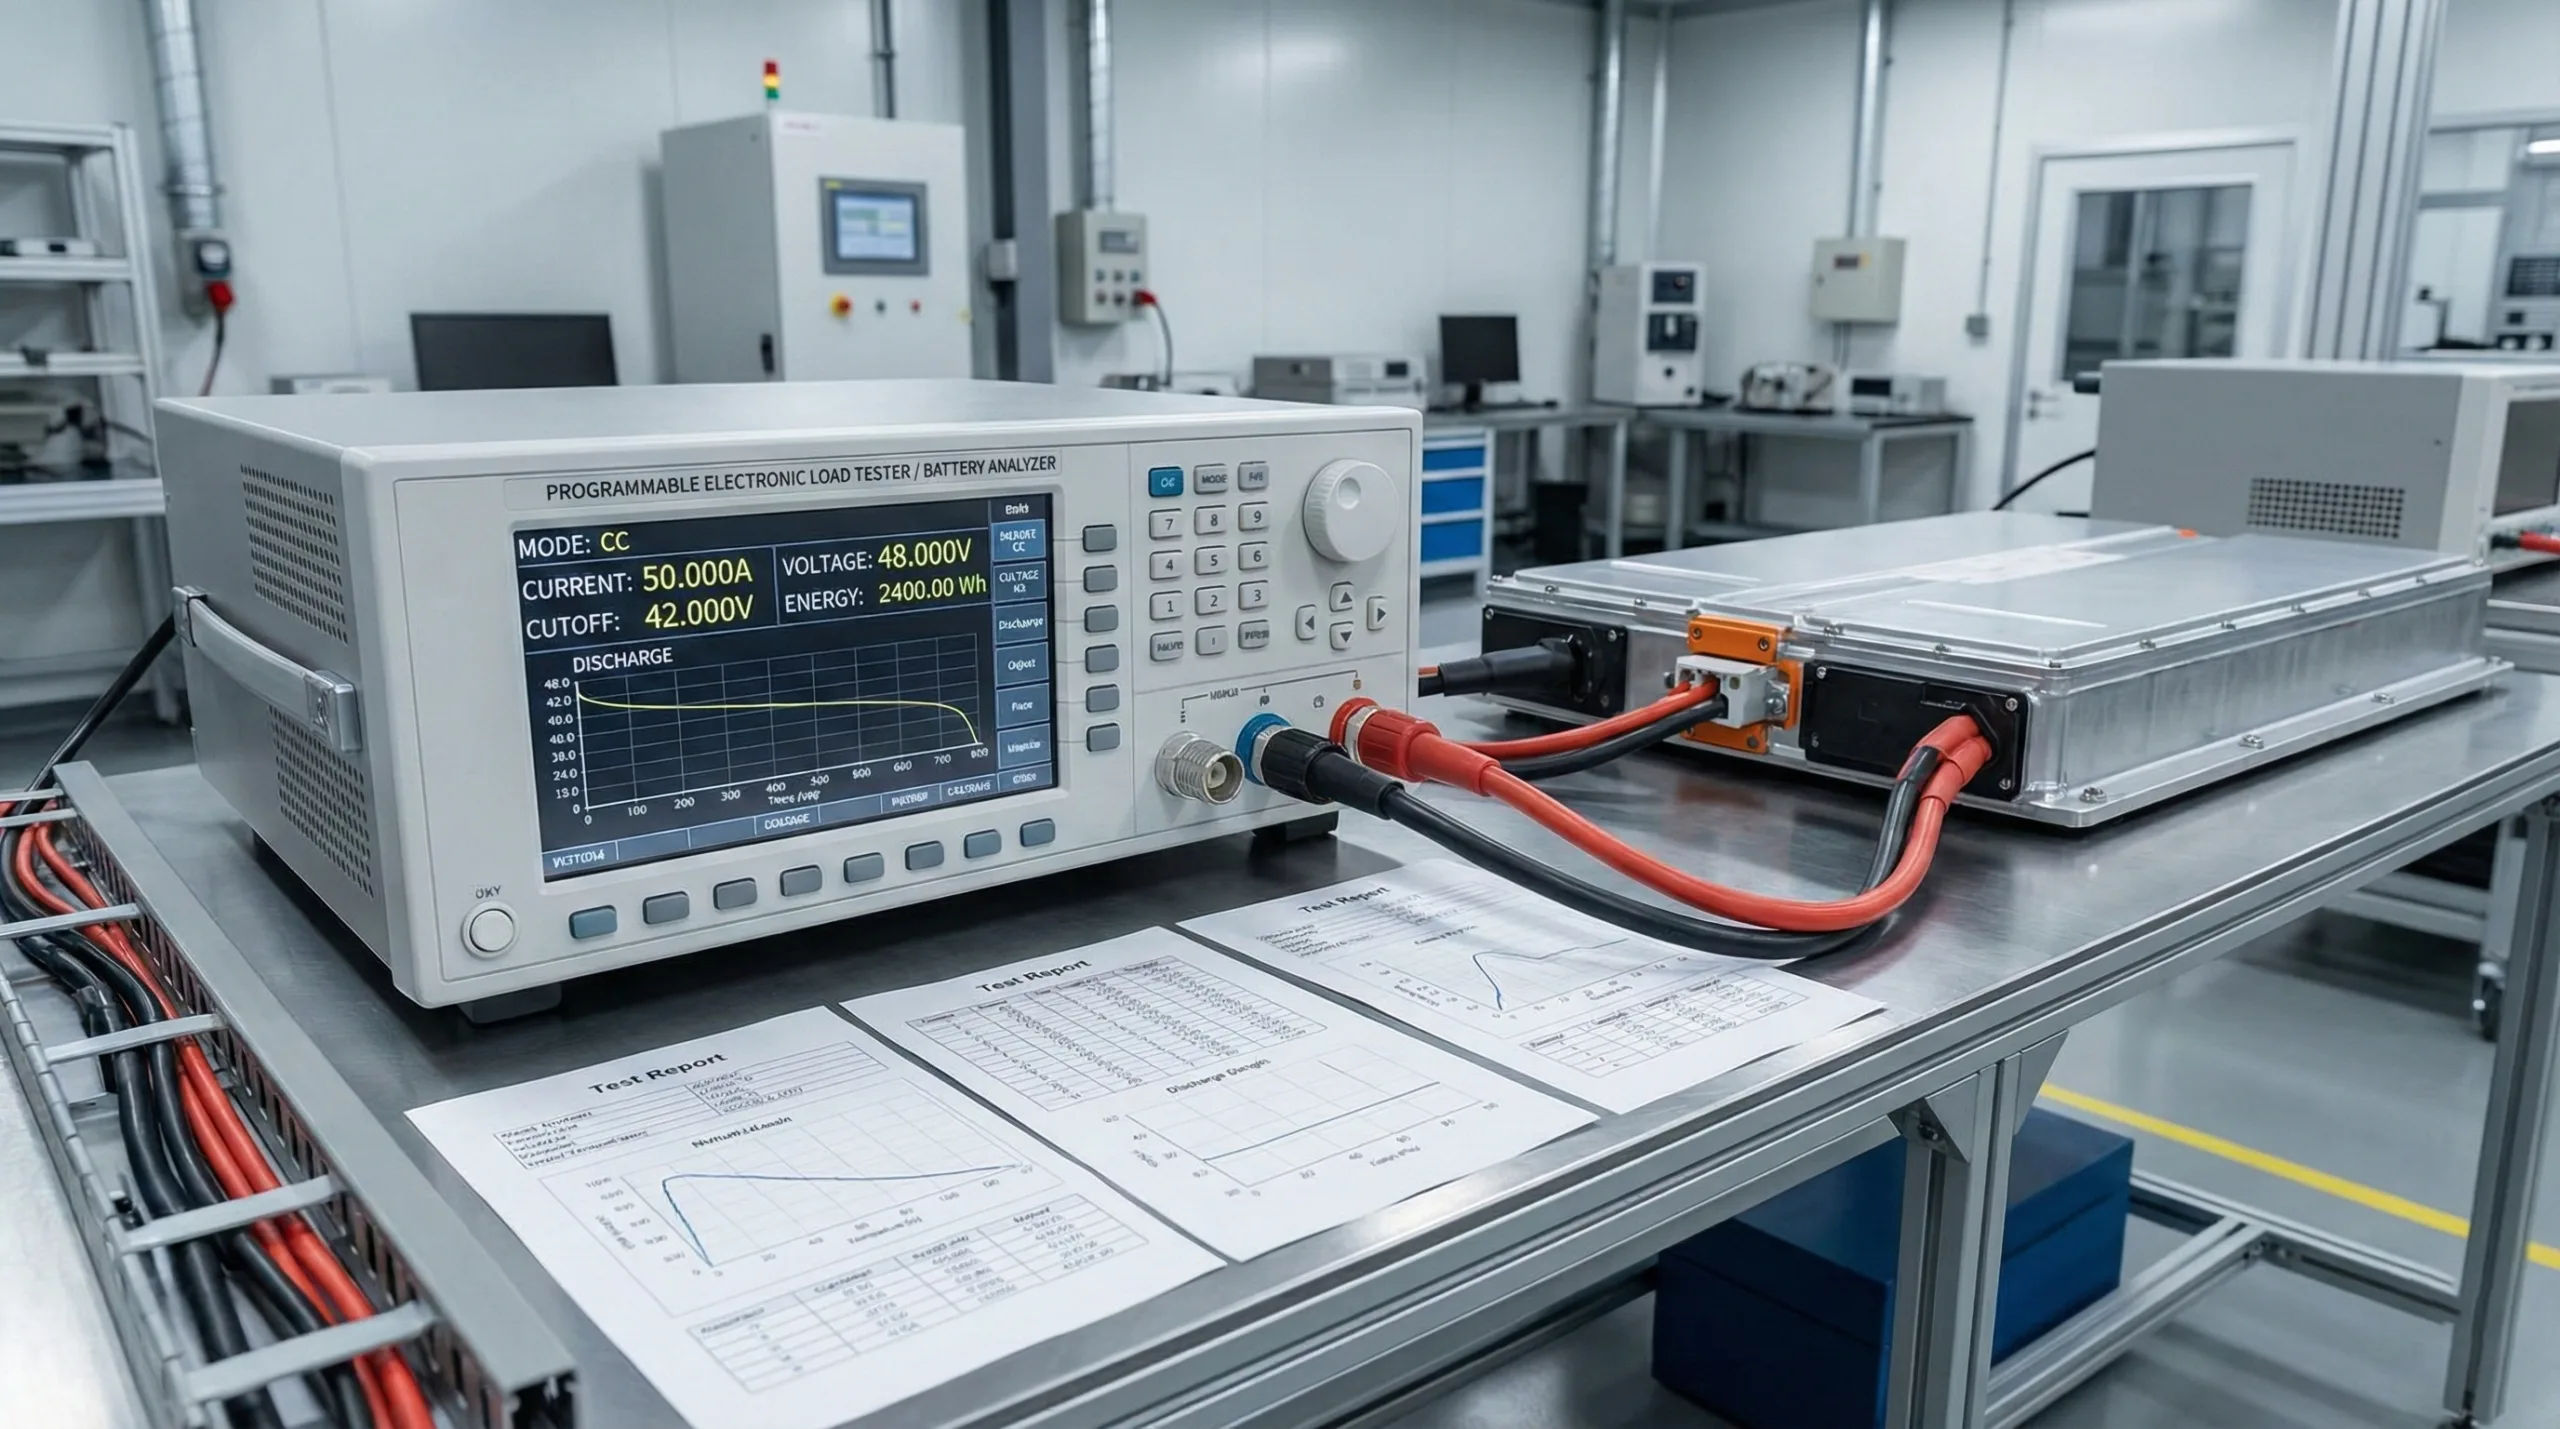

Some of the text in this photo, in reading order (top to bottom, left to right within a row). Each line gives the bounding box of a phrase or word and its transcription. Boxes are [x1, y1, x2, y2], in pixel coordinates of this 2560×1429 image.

[547, 455, 1057, 501] PROGRAMMABLE ELECTRONIC LOAD TESTER / BATTERY ANALYZER
[1201, 474, 1228, 484] MODE
[1210, 514, 1219, 527] 8
[1253, 510, 1262, 523] 9
[1165, 518, 1174, 531] 7
[518, 531, 631, 559] MODE: CC
[782, 537, 972, 577] VOLTAGE: 48.000V
[1209, 554, 1218, 567] 5
[1253, 550, 1262, 563] 6
[1165, 559, 1174, 571] 4
[522, 557, 754, 601] CURRENT: 50.000A
[785, 573, 987, 614] ENERGY: 2400.00 Wh
[1253, 588, 1262, 602] 3
[1166, 600, 1174, 613] 1
[1209, 594, 1218, 607] 2
[526, 594, 754, 640] CUTOFF: 42.000V
[573, 646, 674, 674] DISCHARGE
[544, 677, 571, 690] 48.0
[548, 713, 574, 726] 40.0
[584, 815, 593, 826] 0
[627, 804, 648, 817] 100
[673, 796, 695, 809] 200
[720, 789, 741, 802] 300
[765, 782, 787, 794] 400
[893, 760, 913, 773] 600
[572, 804, 581, 814] 0
[1297, 897, 1340, 914] Test
[975, 960, 1093, 993] Test Report
[588, 1053, 729, 1094] Test Report
